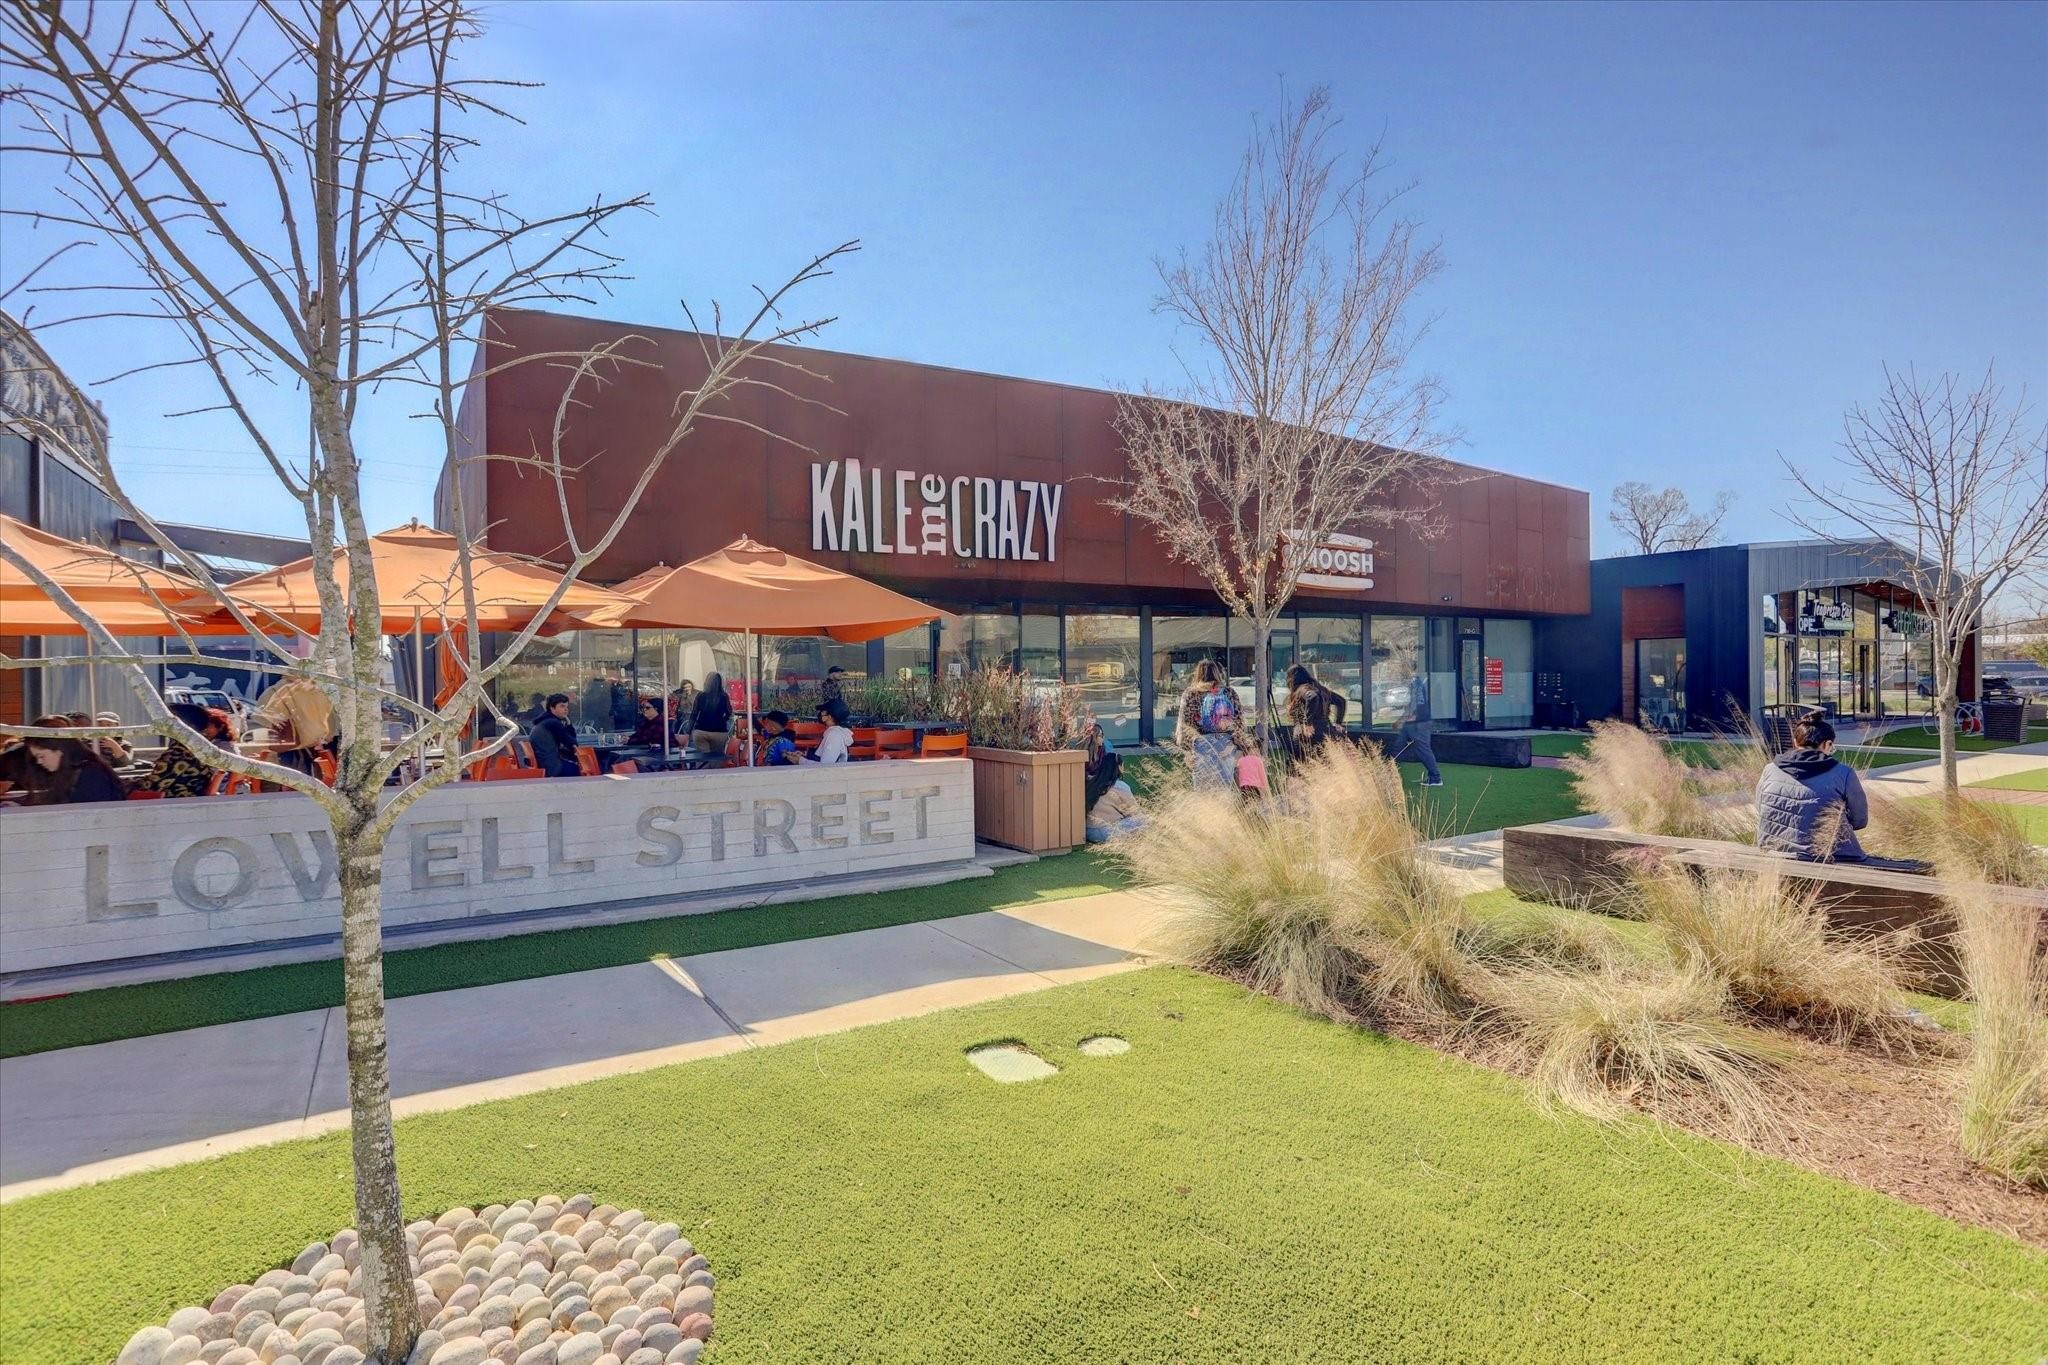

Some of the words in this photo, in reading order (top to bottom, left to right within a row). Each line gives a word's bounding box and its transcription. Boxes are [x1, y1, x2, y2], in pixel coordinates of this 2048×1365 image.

[811, 458, 917, 554] KALE
[921, 474, 946, 555] me
[951, 476, 1063, 561] CRAZY
[635, 785, 941, 867] STREET
